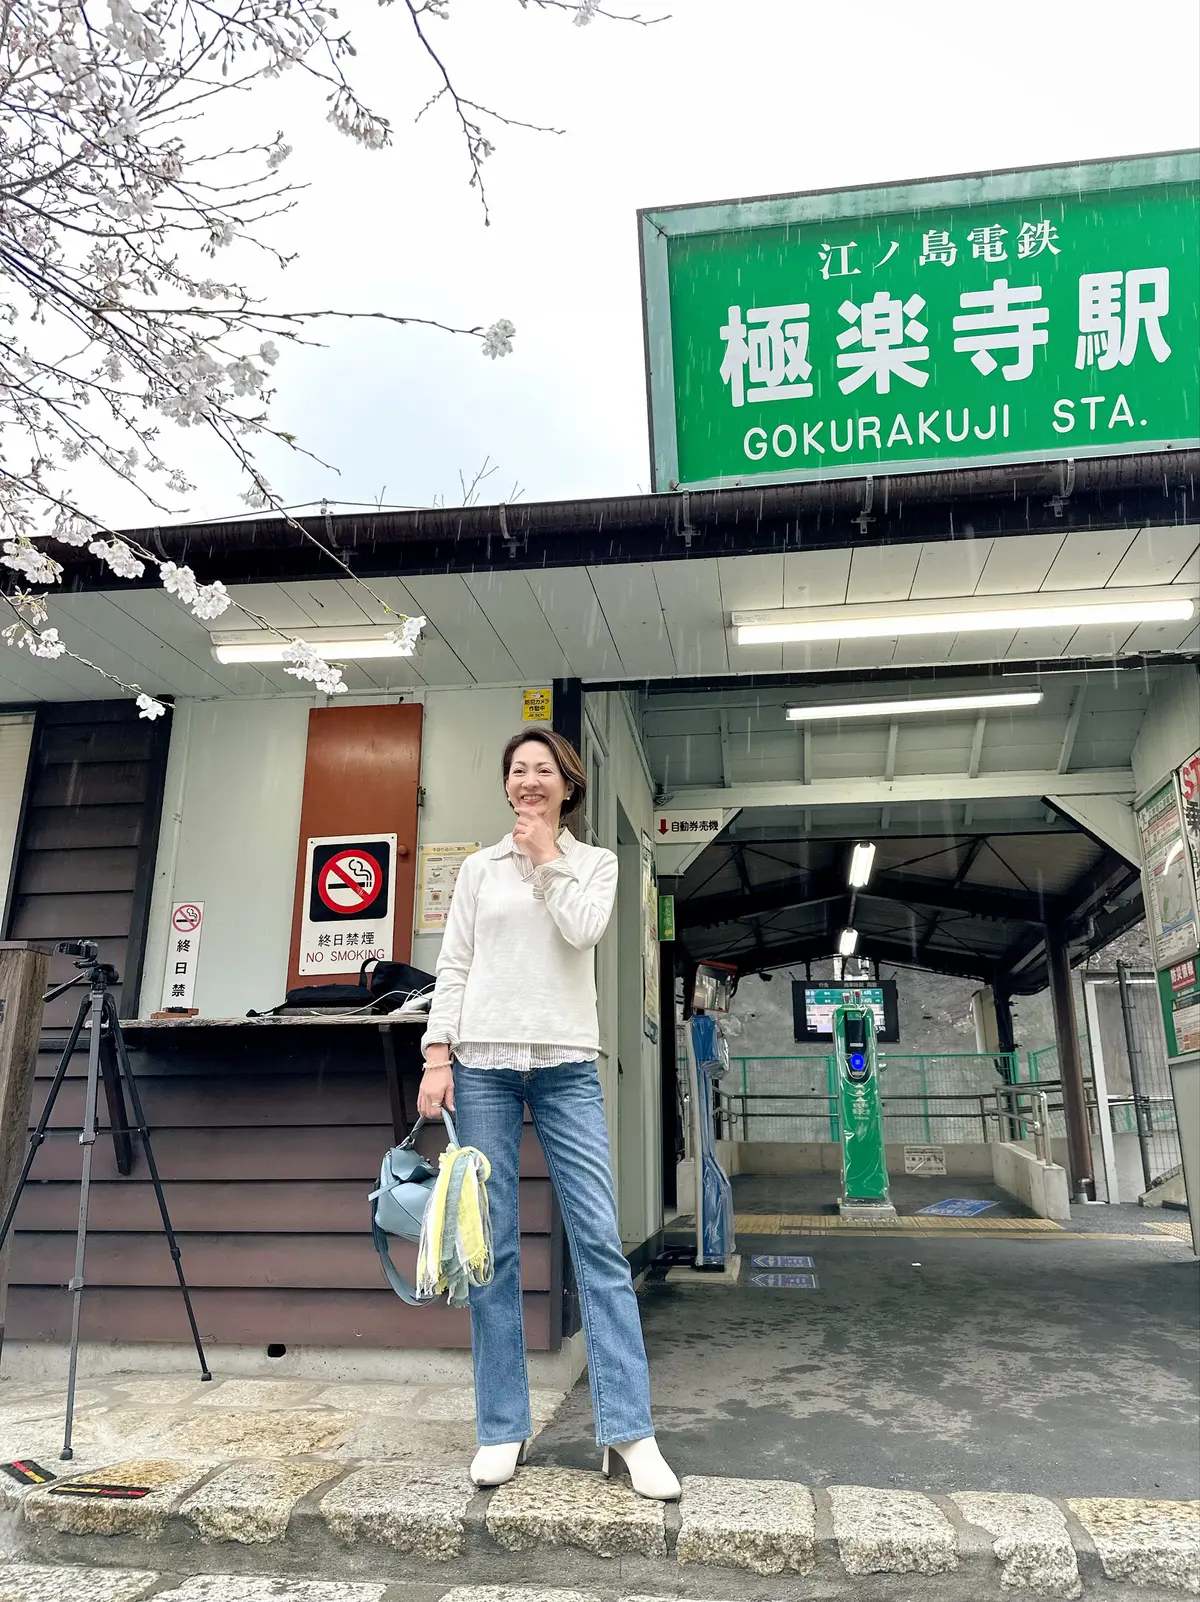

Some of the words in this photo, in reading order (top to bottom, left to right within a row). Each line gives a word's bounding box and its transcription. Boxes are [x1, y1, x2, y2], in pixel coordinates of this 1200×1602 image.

[818, 219, 1062, 280] 江ノ島電鉄
[719, 266, 1171, 407] 極楽寺駅
[743, 404, 1010, 461] GOKURAKUJI
[1052, 394, 1148, 433] STA.
[671, 820, 719, 832] 自動券売機
[306, 951, 324, 963] NO
[330, 948, 385, 962] SMOKING
[318, 931, 375, 947] 終日禁煙
[171, 939, 191, 1008] 終日禁
